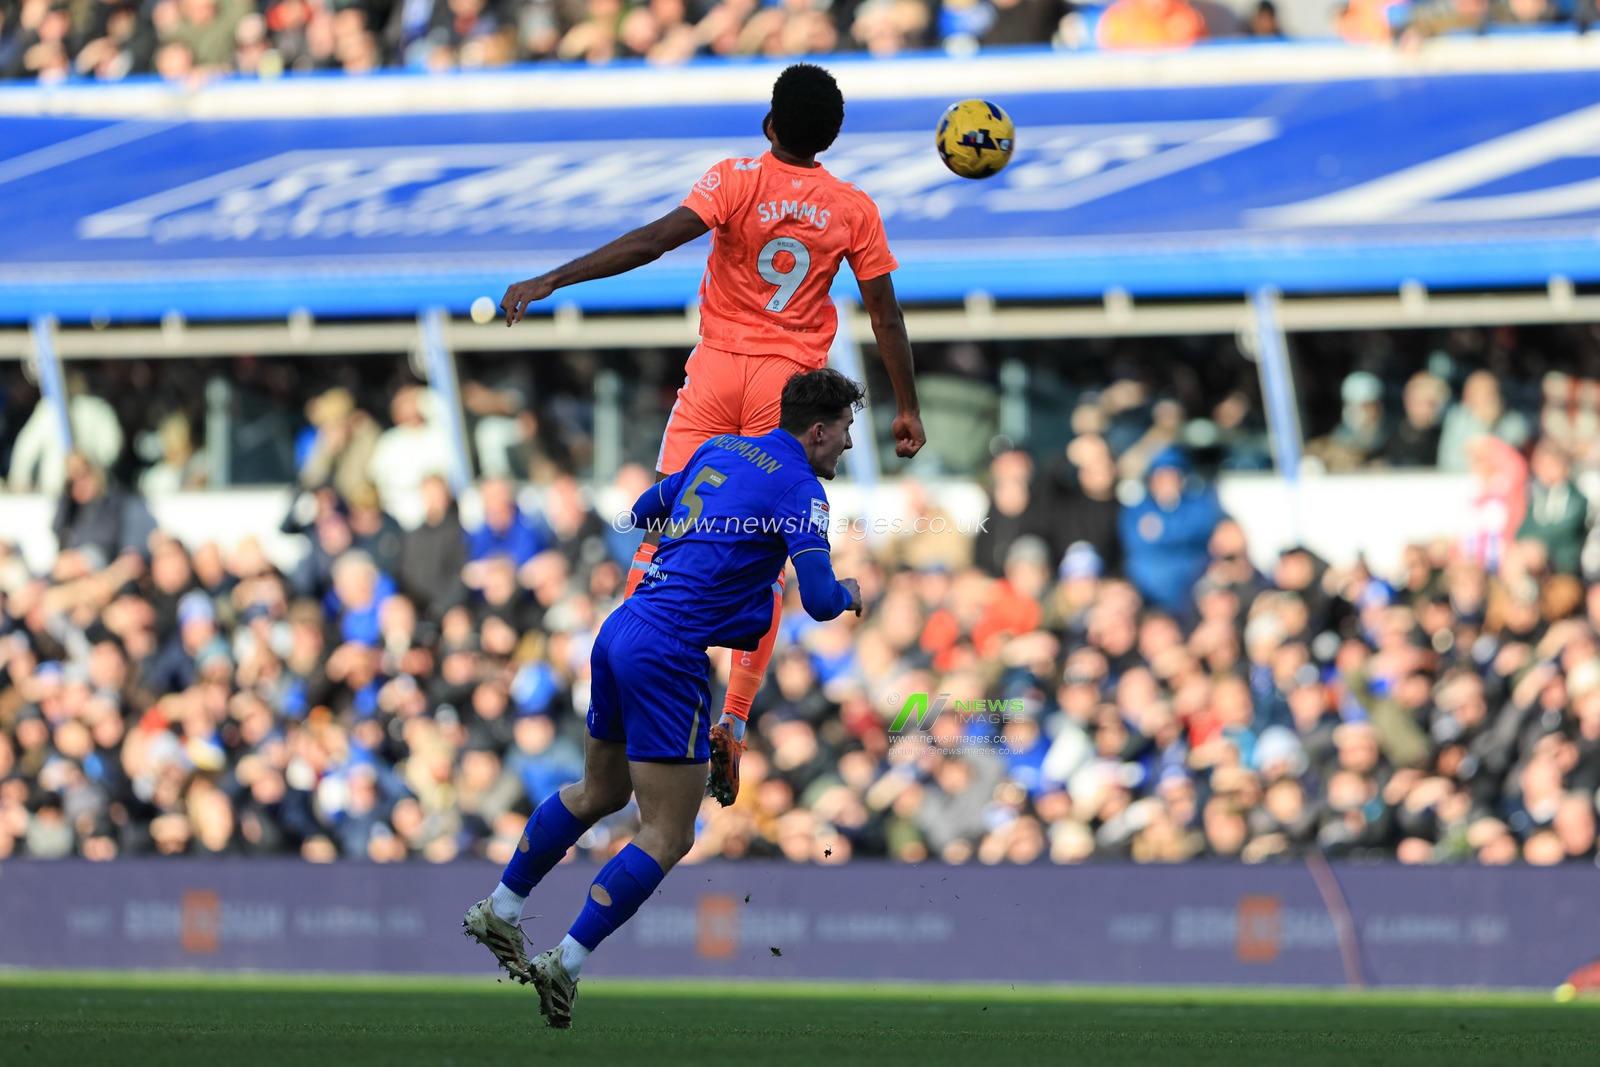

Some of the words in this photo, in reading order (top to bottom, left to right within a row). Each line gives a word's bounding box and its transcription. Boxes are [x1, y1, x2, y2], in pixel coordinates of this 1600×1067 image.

[757, 200, 831, 229] SIMMS
[756, 236, 811, 313] 9
[709, 435, 783, 475] NEUMANN
[665, 465, 728, 540] 5
